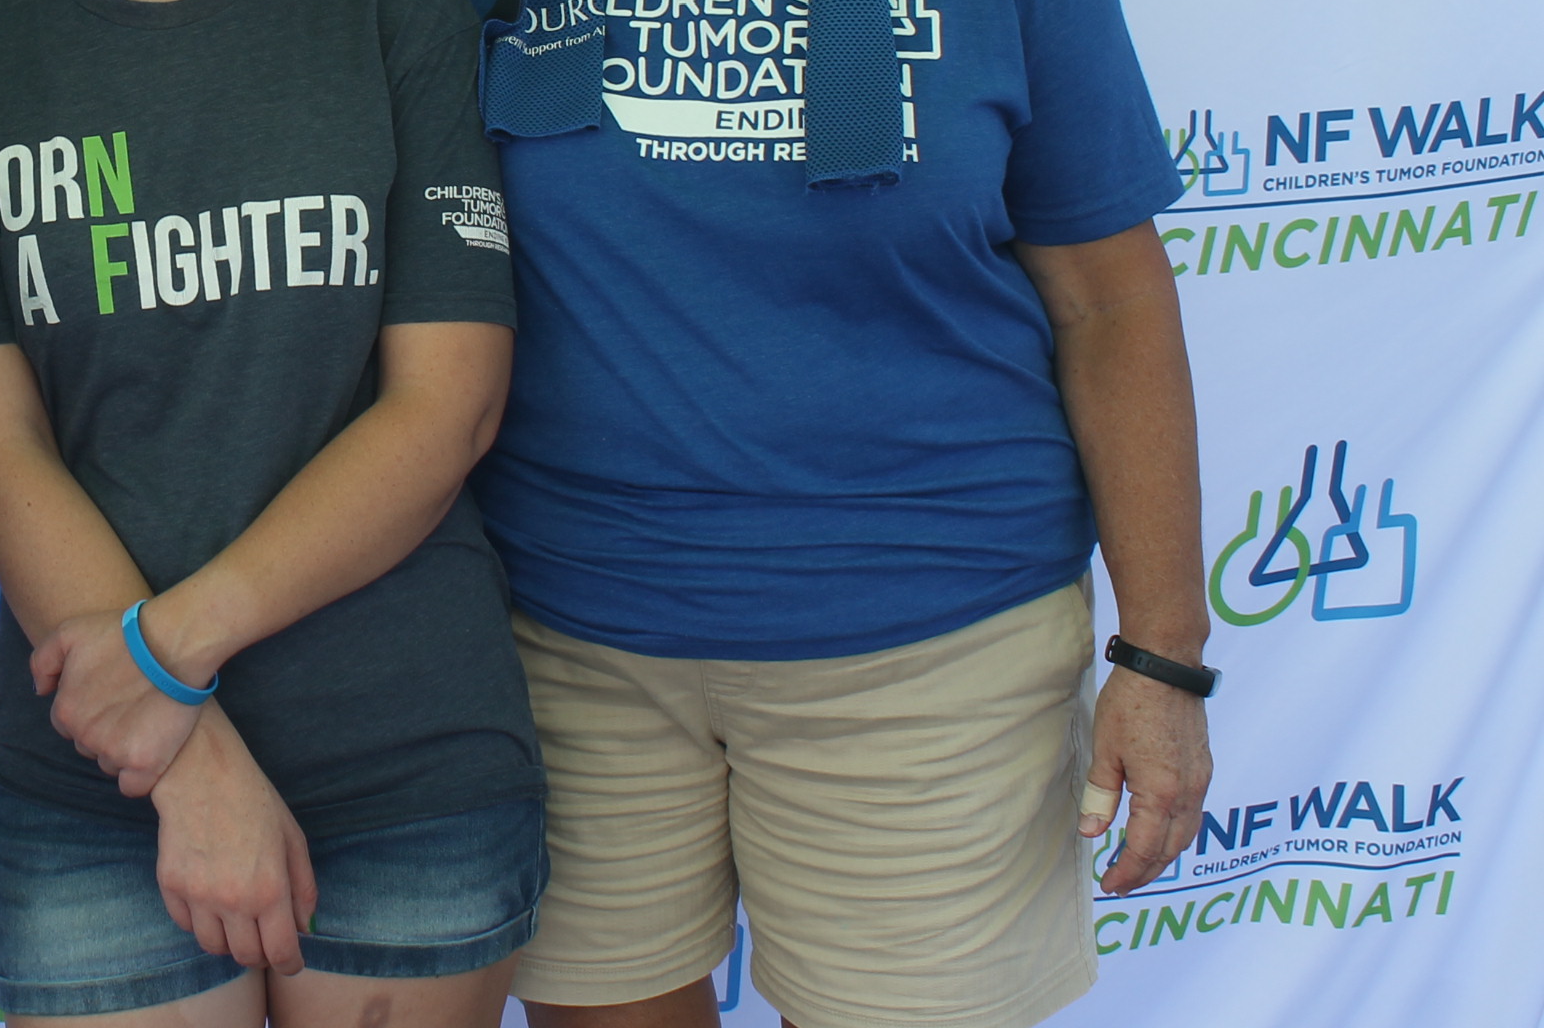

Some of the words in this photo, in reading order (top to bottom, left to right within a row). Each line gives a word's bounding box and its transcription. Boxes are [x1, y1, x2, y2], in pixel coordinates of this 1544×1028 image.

[635, 137, 764, 163] THROUGH
[1264, 108, 1354, 167] NF
[1368, 89, 1544, 159] WALK
[1262, 170, 1370, 193] CHILDREN'S
[1375, 164, 1436, 184] TUMOR
[17, 233, 61, 327] A
[90, 193, 380, 316] FIGHTER.
[1158, 189, 1538, 278] CINCINNATI
[1192, 843, 1280, 877] CHILDREN'S
[1284, 838, 1349, 854] TUMOR
[1354, 830, 1463, 857] FOUNDATION
[1195, 800, 1279, 856] NF
[1289, 776, 1466, 833] WALK
[1094, 870, 1456, 956] CINCINNATI
